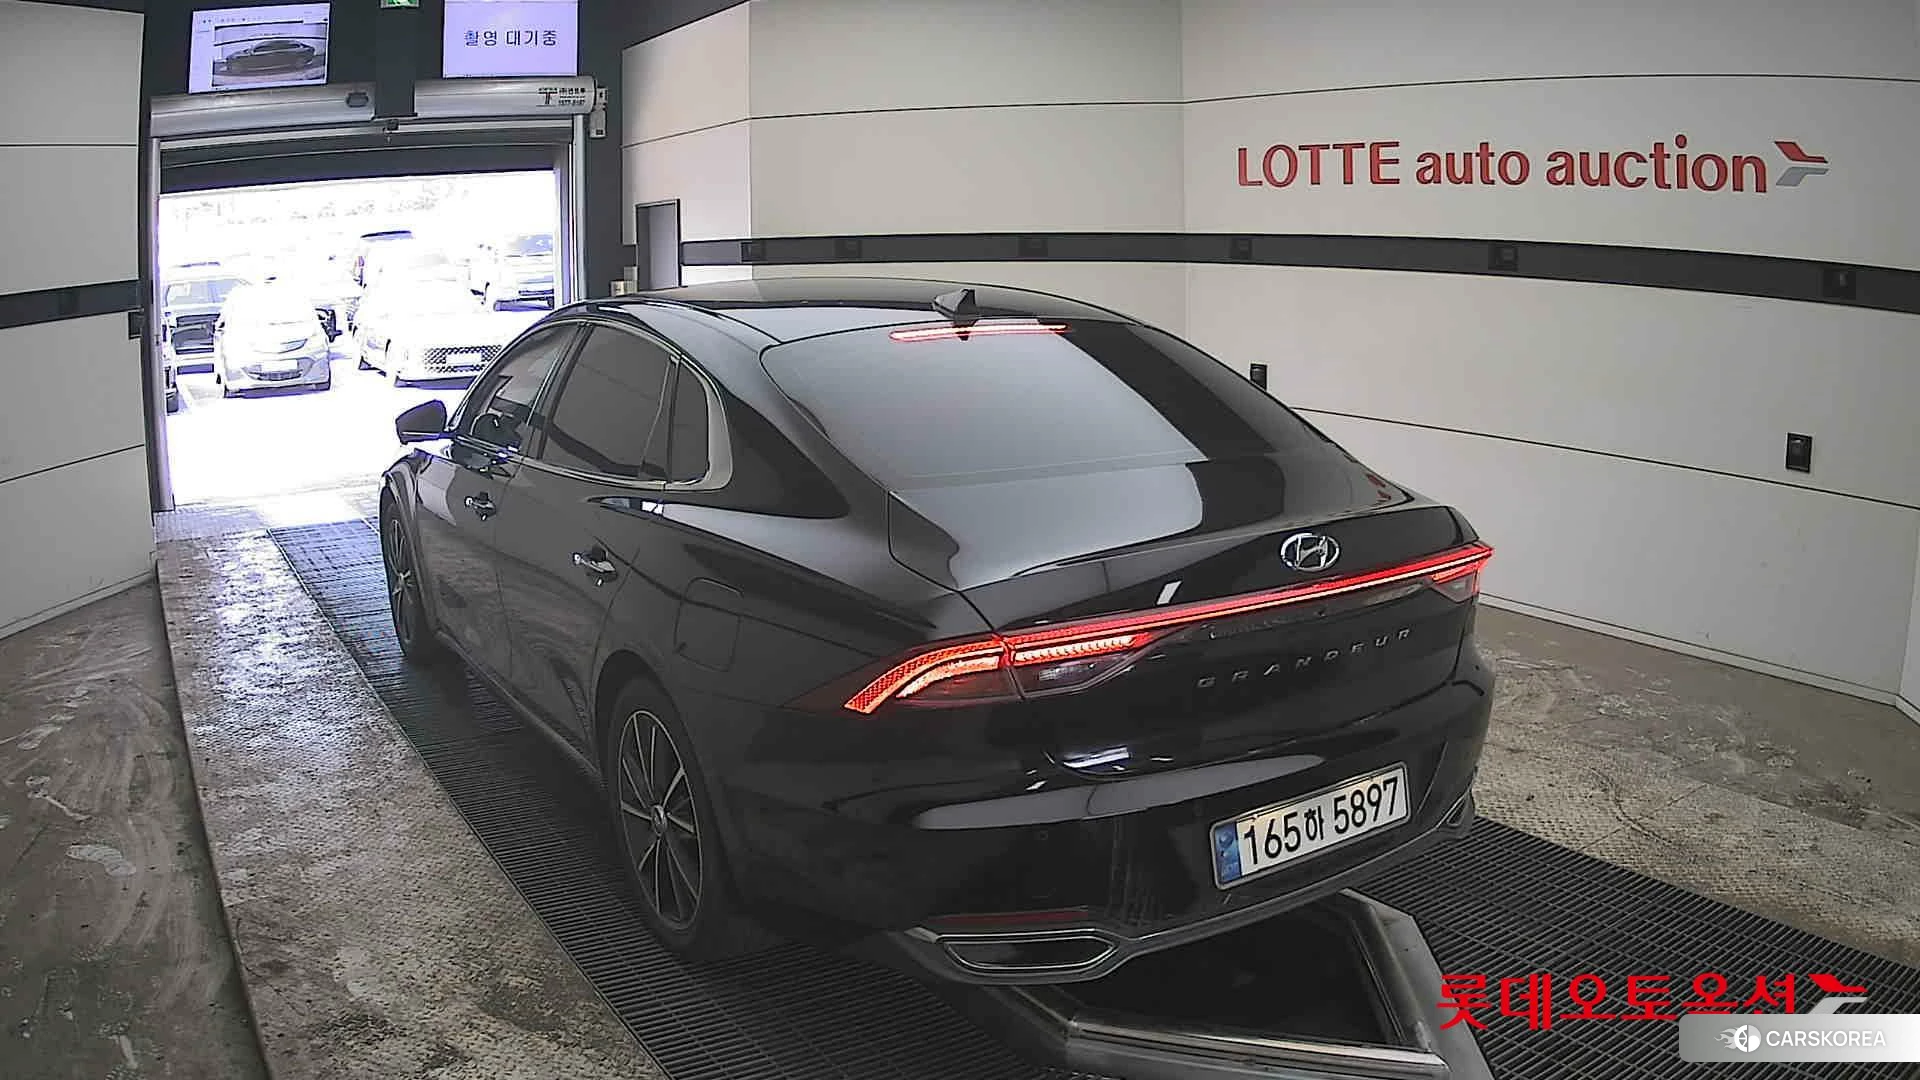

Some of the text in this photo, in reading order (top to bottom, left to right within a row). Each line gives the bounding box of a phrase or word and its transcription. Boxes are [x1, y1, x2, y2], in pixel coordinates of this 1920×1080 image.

[506, 30, 557, 46] 대기중
[1237, 133, 1768, 194] LOTTE auto auction
[1243, 805, 1325, 865] 165하
[1333, 776, 1399, 834] 5897
